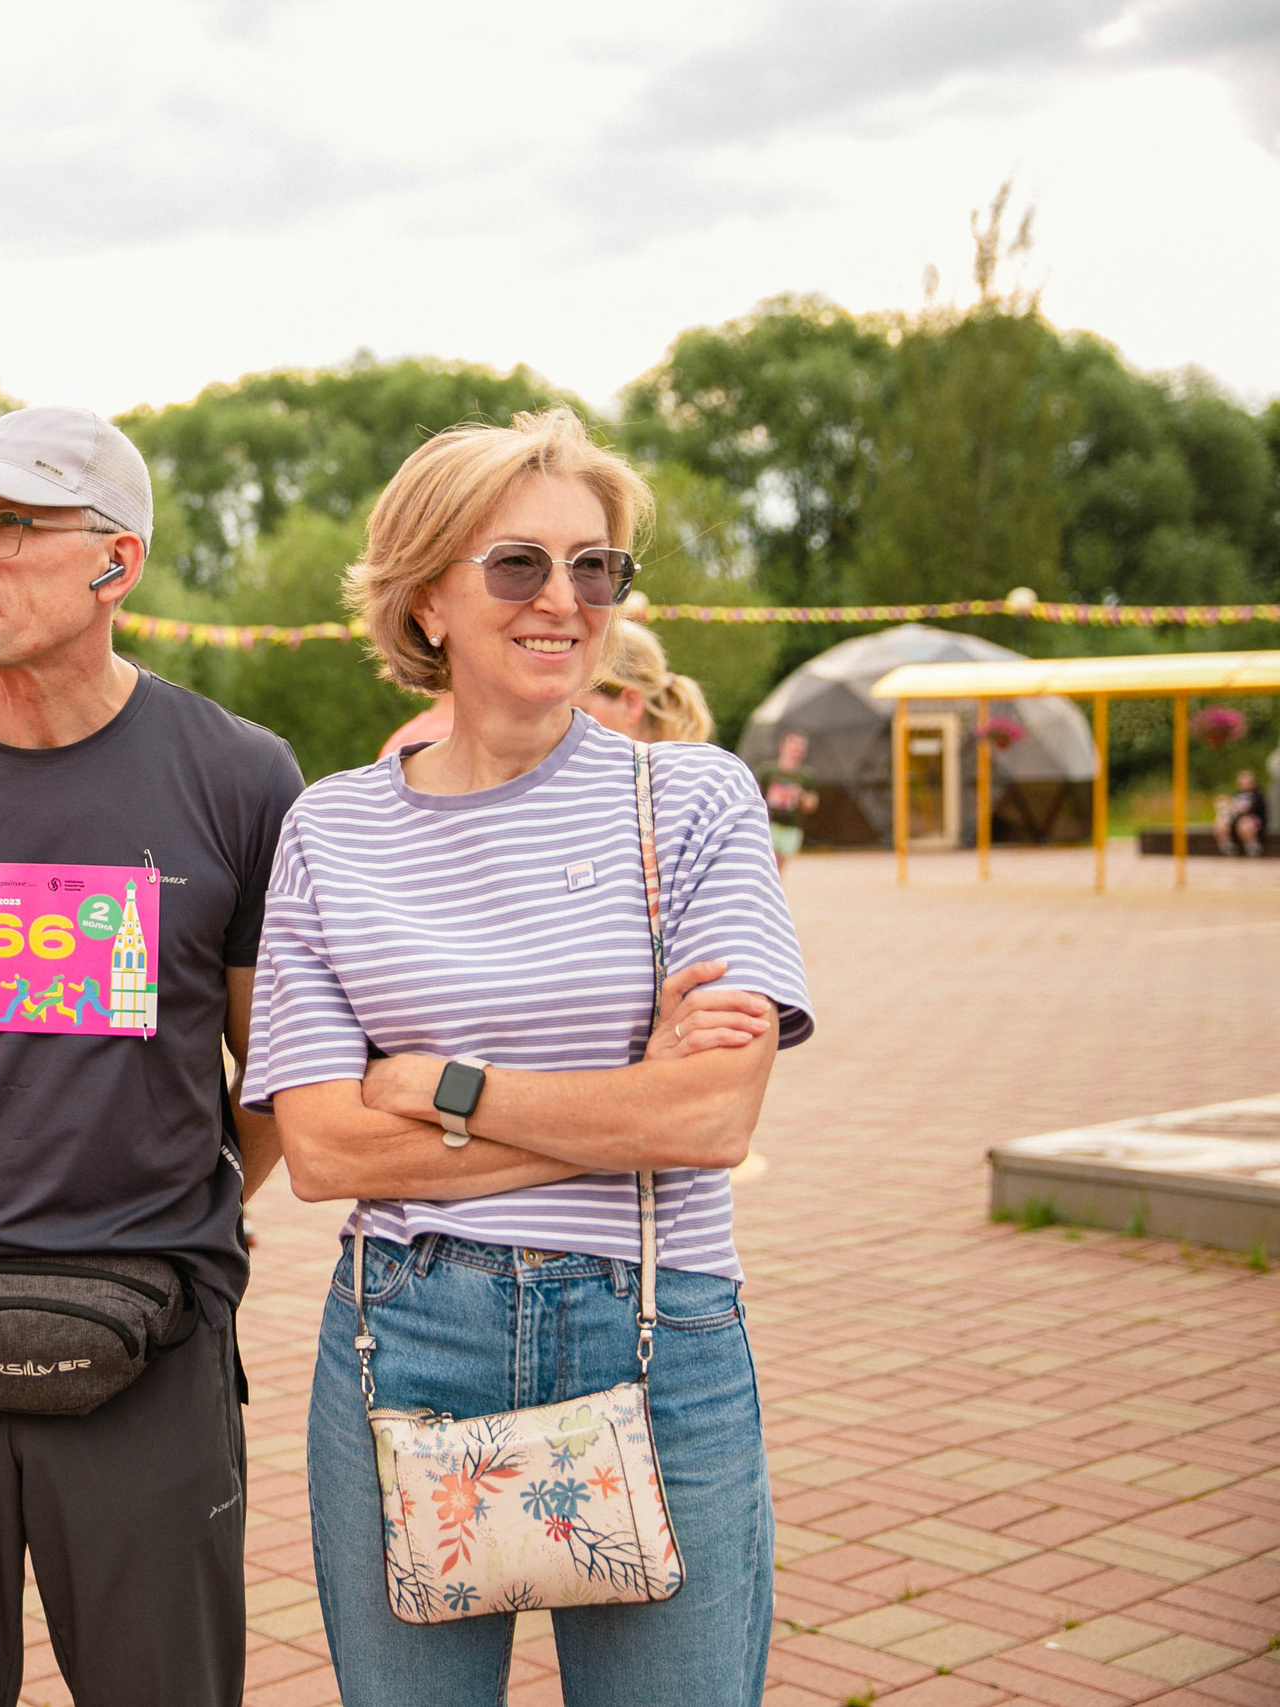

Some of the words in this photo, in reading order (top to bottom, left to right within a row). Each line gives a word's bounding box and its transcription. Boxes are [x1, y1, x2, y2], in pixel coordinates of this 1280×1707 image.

[160, 876, 189, 885] MIX
[89, 902, 110, 922] 2
[82, 920, 113, 931] ВОЛНА
